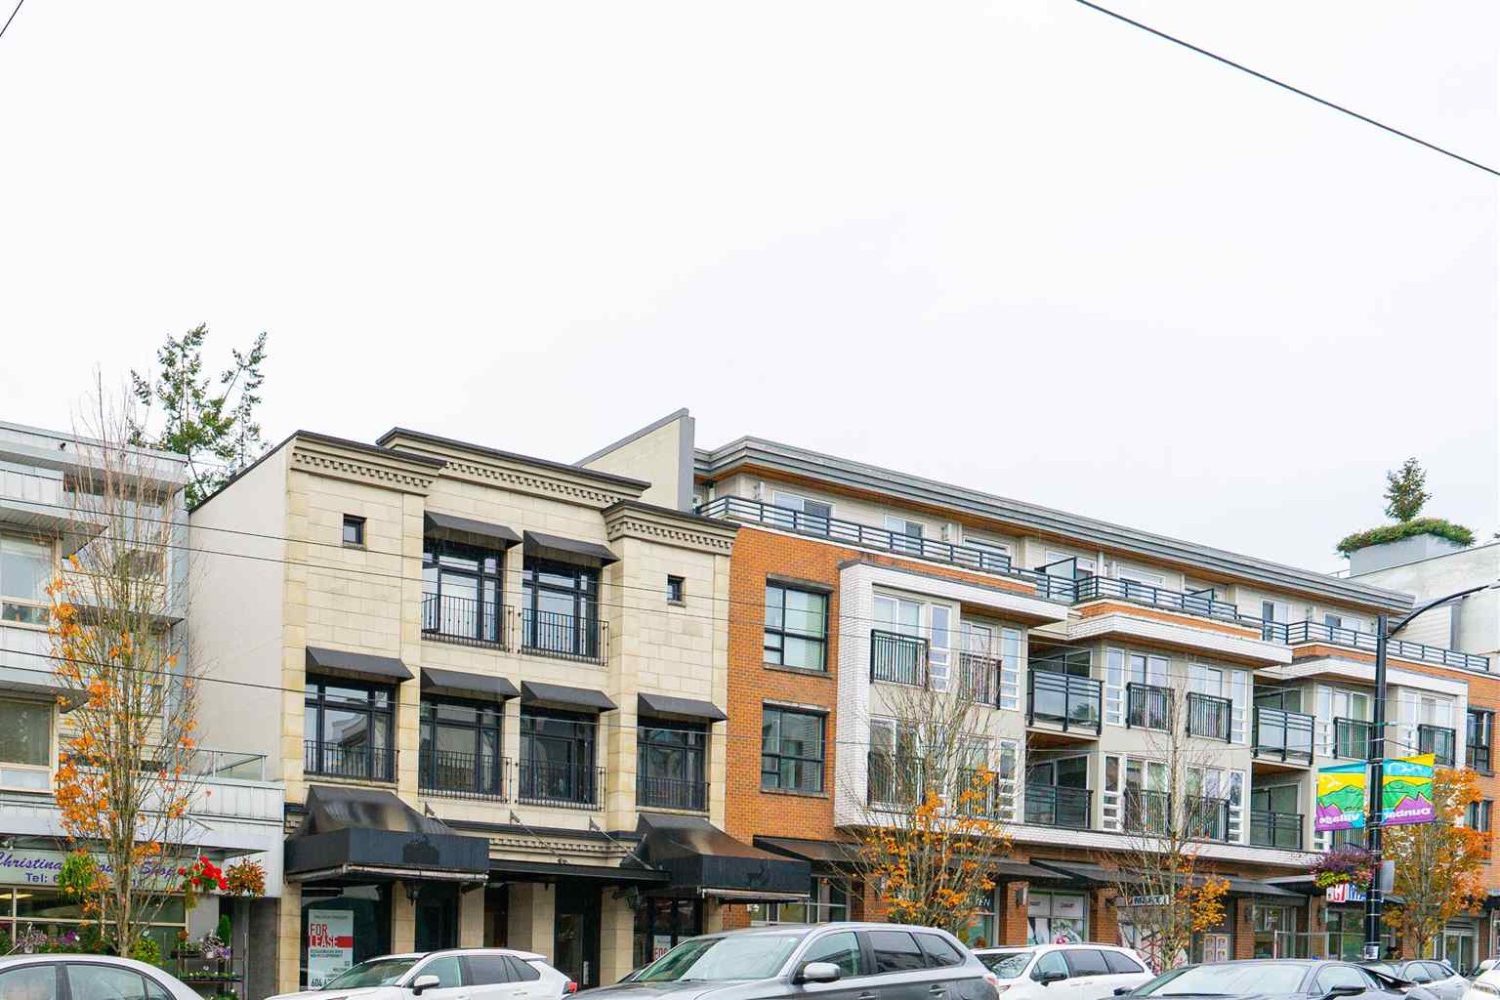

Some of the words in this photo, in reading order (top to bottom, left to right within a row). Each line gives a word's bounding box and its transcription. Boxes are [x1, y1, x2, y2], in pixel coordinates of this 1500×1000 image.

[25, 872, 48, 883] Tel:
[310, 923, 328, 936] FOR
[310, 936, 338, 948] LEASE
